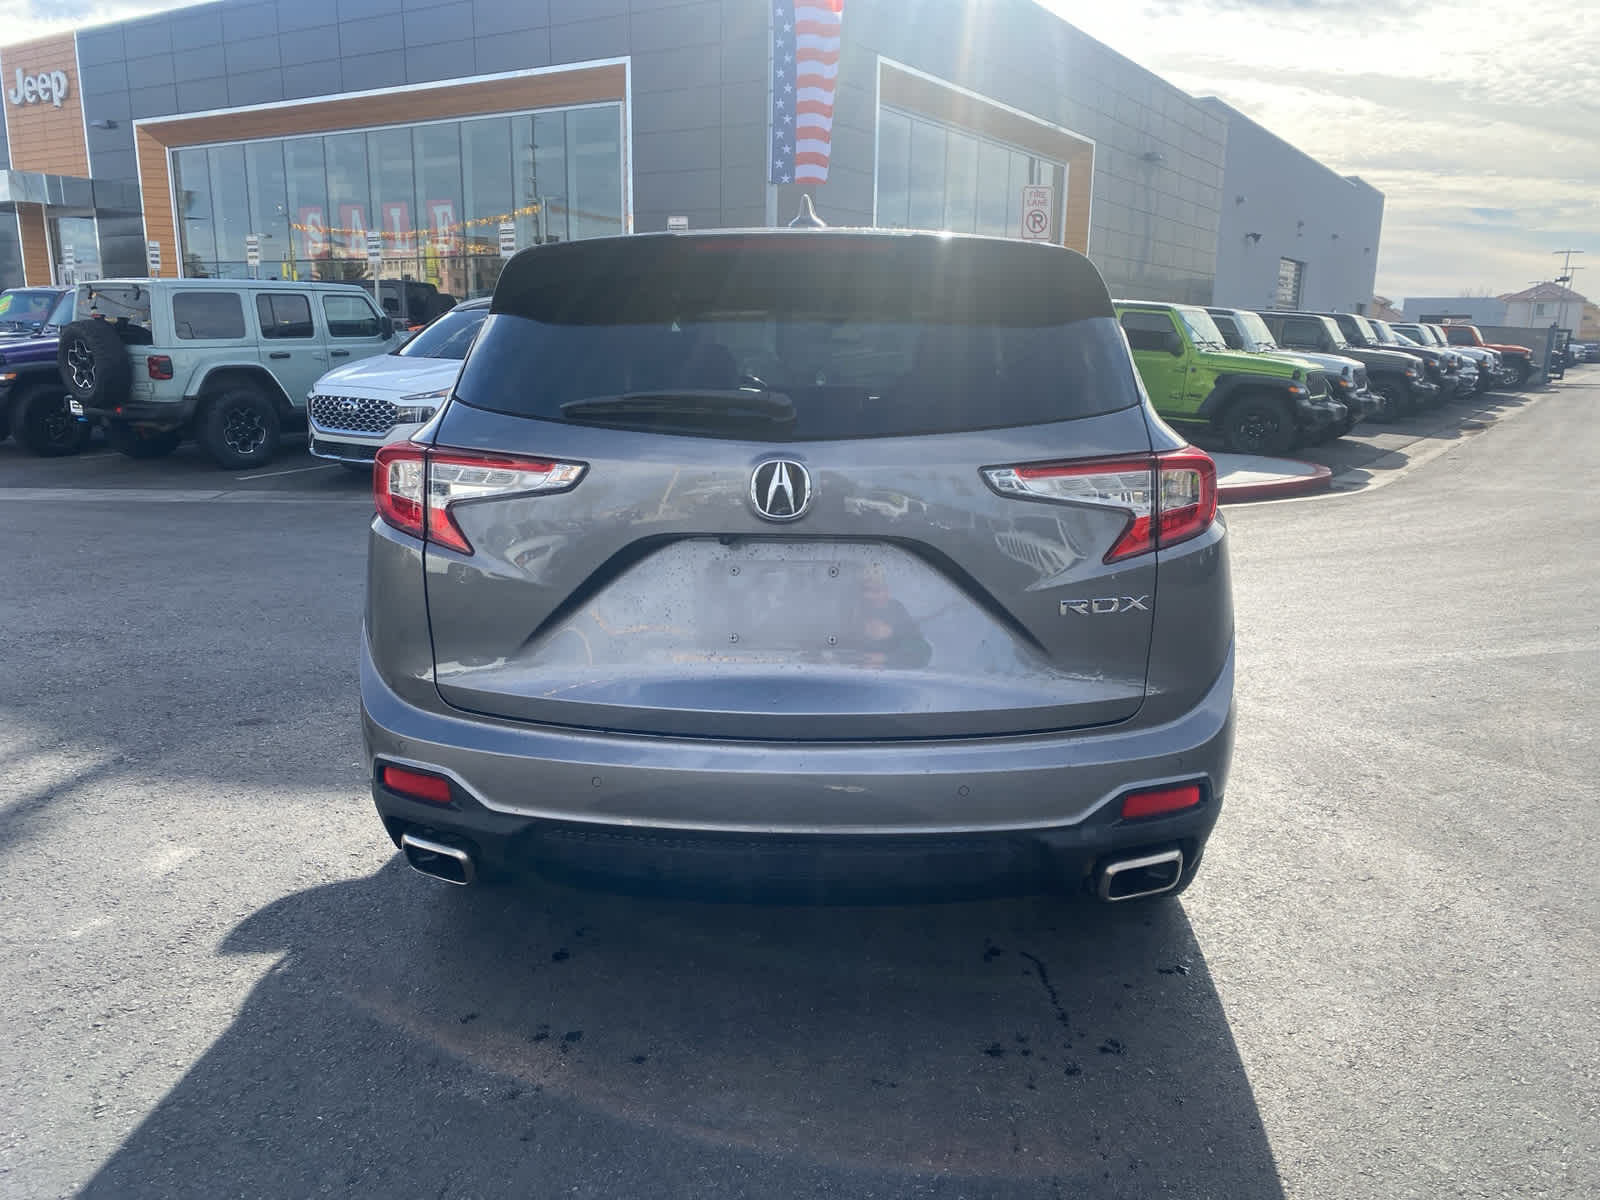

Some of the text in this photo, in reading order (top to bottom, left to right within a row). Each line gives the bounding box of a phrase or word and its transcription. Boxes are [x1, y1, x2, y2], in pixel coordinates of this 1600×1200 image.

[7, 66, 68, 107] Jeep
[1027, 200, 1048, 208] LANE
[1029, 191, 1048, 199] FIRE
[303, 203, 458, 256] SALE
[1060, 594, 1149, 616] RDX
